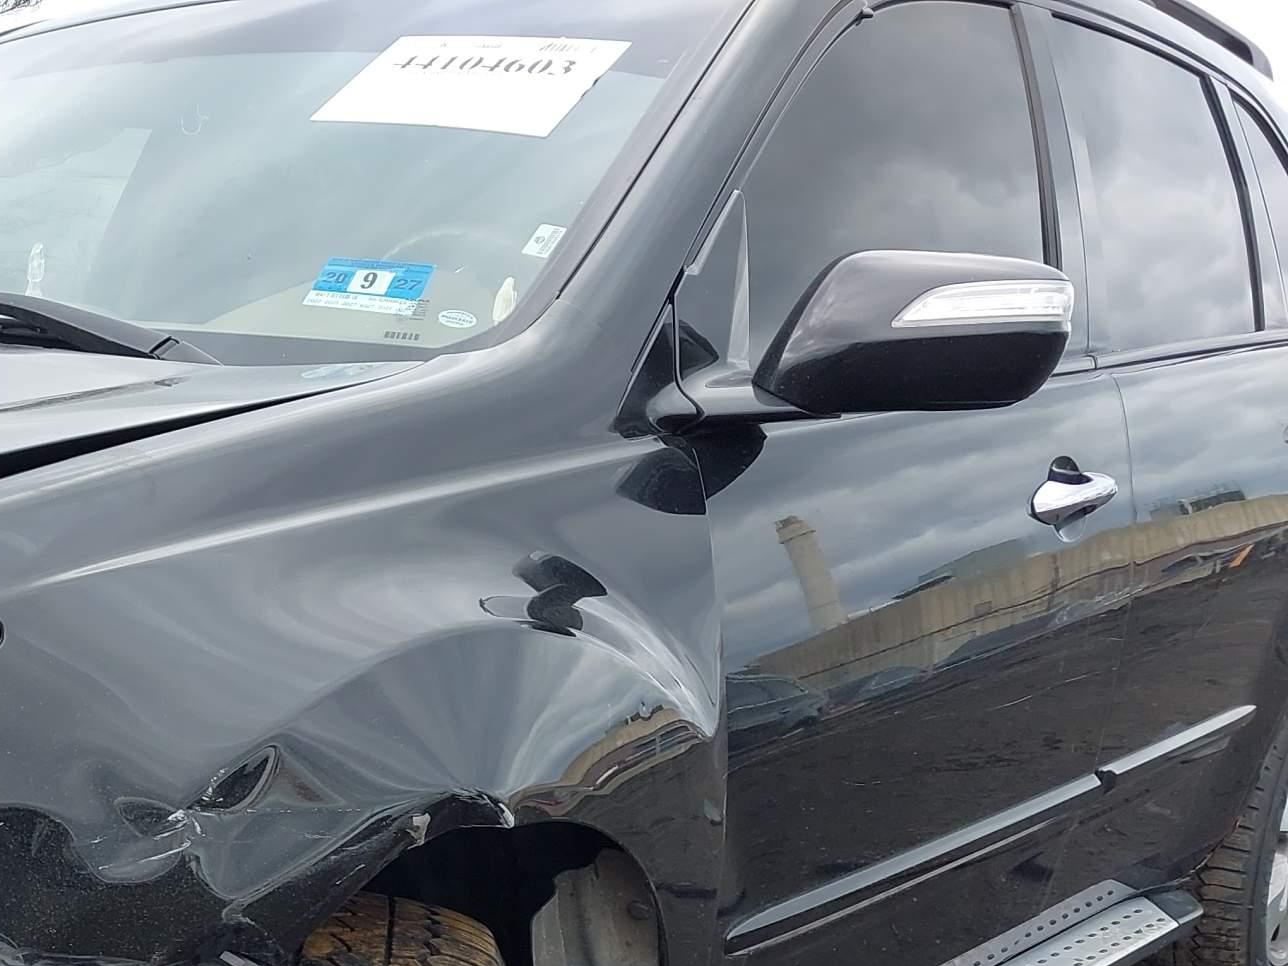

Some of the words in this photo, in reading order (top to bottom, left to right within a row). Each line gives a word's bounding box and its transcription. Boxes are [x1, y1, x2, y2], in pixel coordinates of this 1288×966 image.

[321, 271, 349, 285] 20
[359, 271, 379, 290] 9
[393, 278, 423, 292] 27
